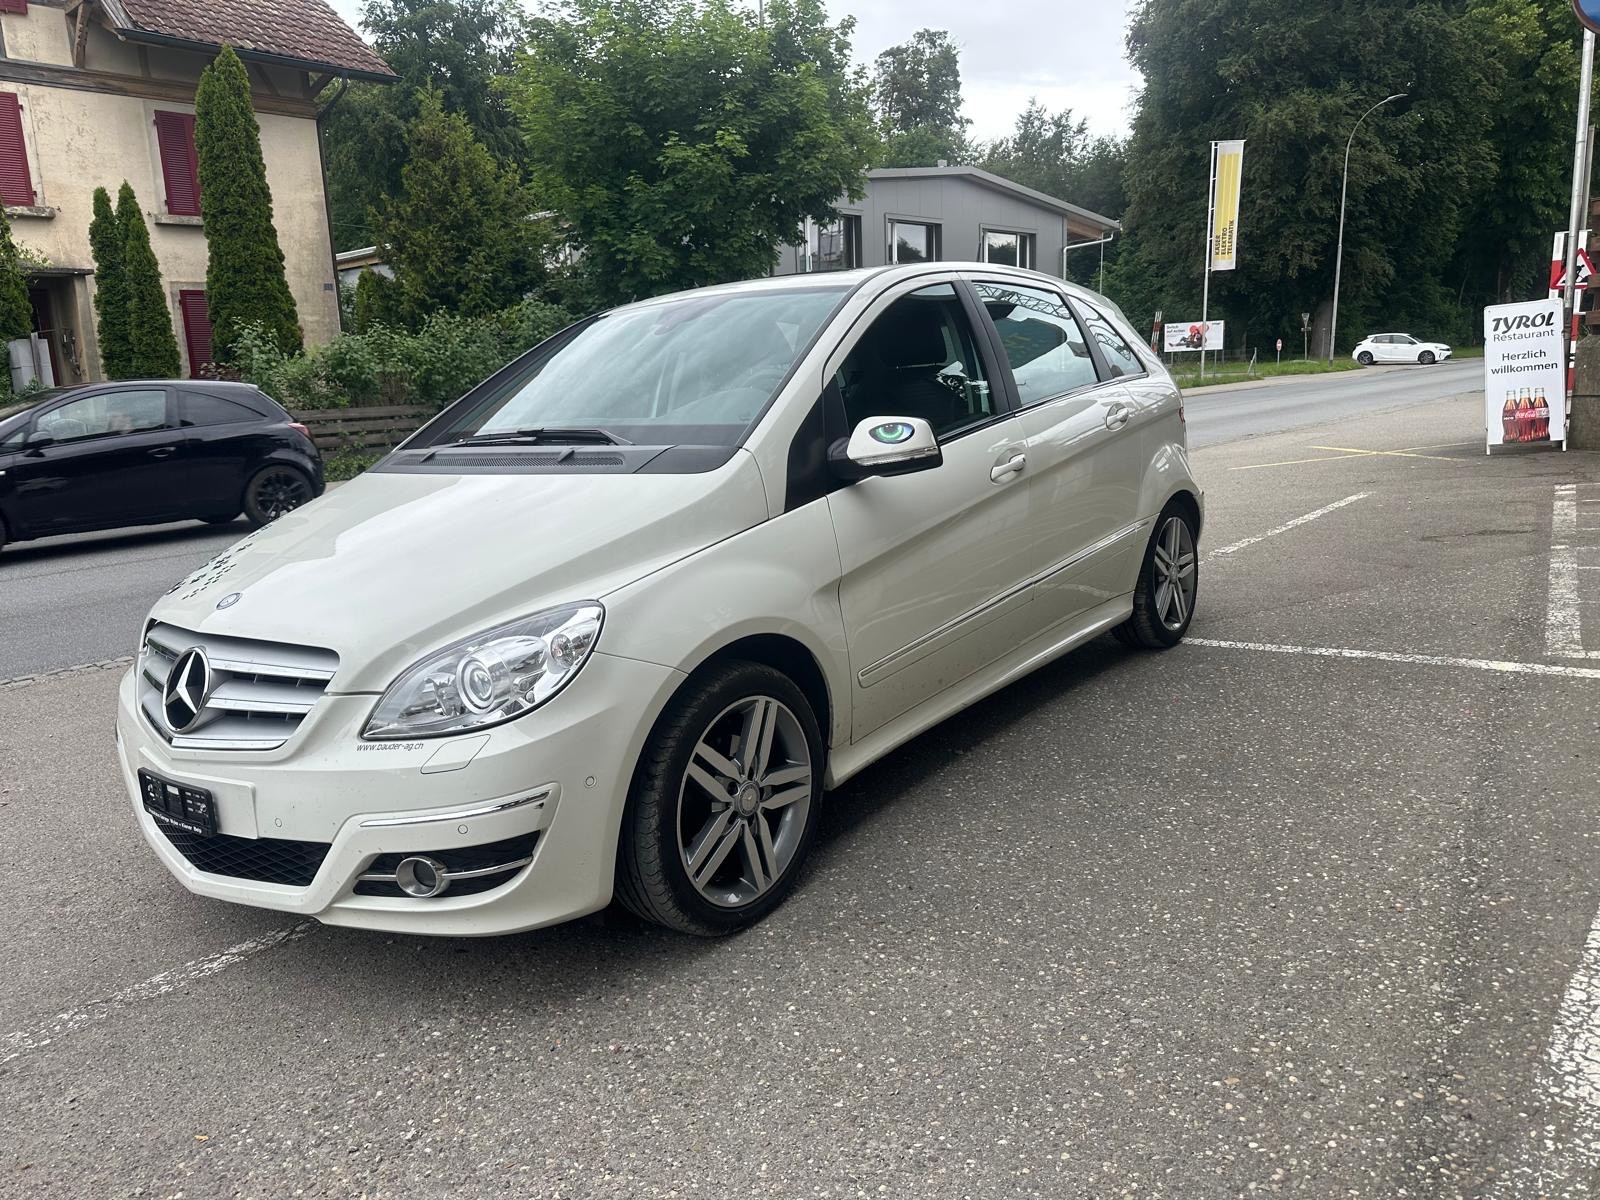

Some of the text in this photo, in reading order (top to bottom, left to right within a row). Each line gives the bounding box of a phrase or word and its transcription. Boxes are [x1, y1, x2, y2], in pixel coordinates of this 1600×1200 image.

[1492, 312, 1554, 334] TYROL
[1493, 329, 1555, 342] Restaurant
[1502, 349, 1546, 361] Herzlich
[1491, 362, 1558, 374] willkommen
